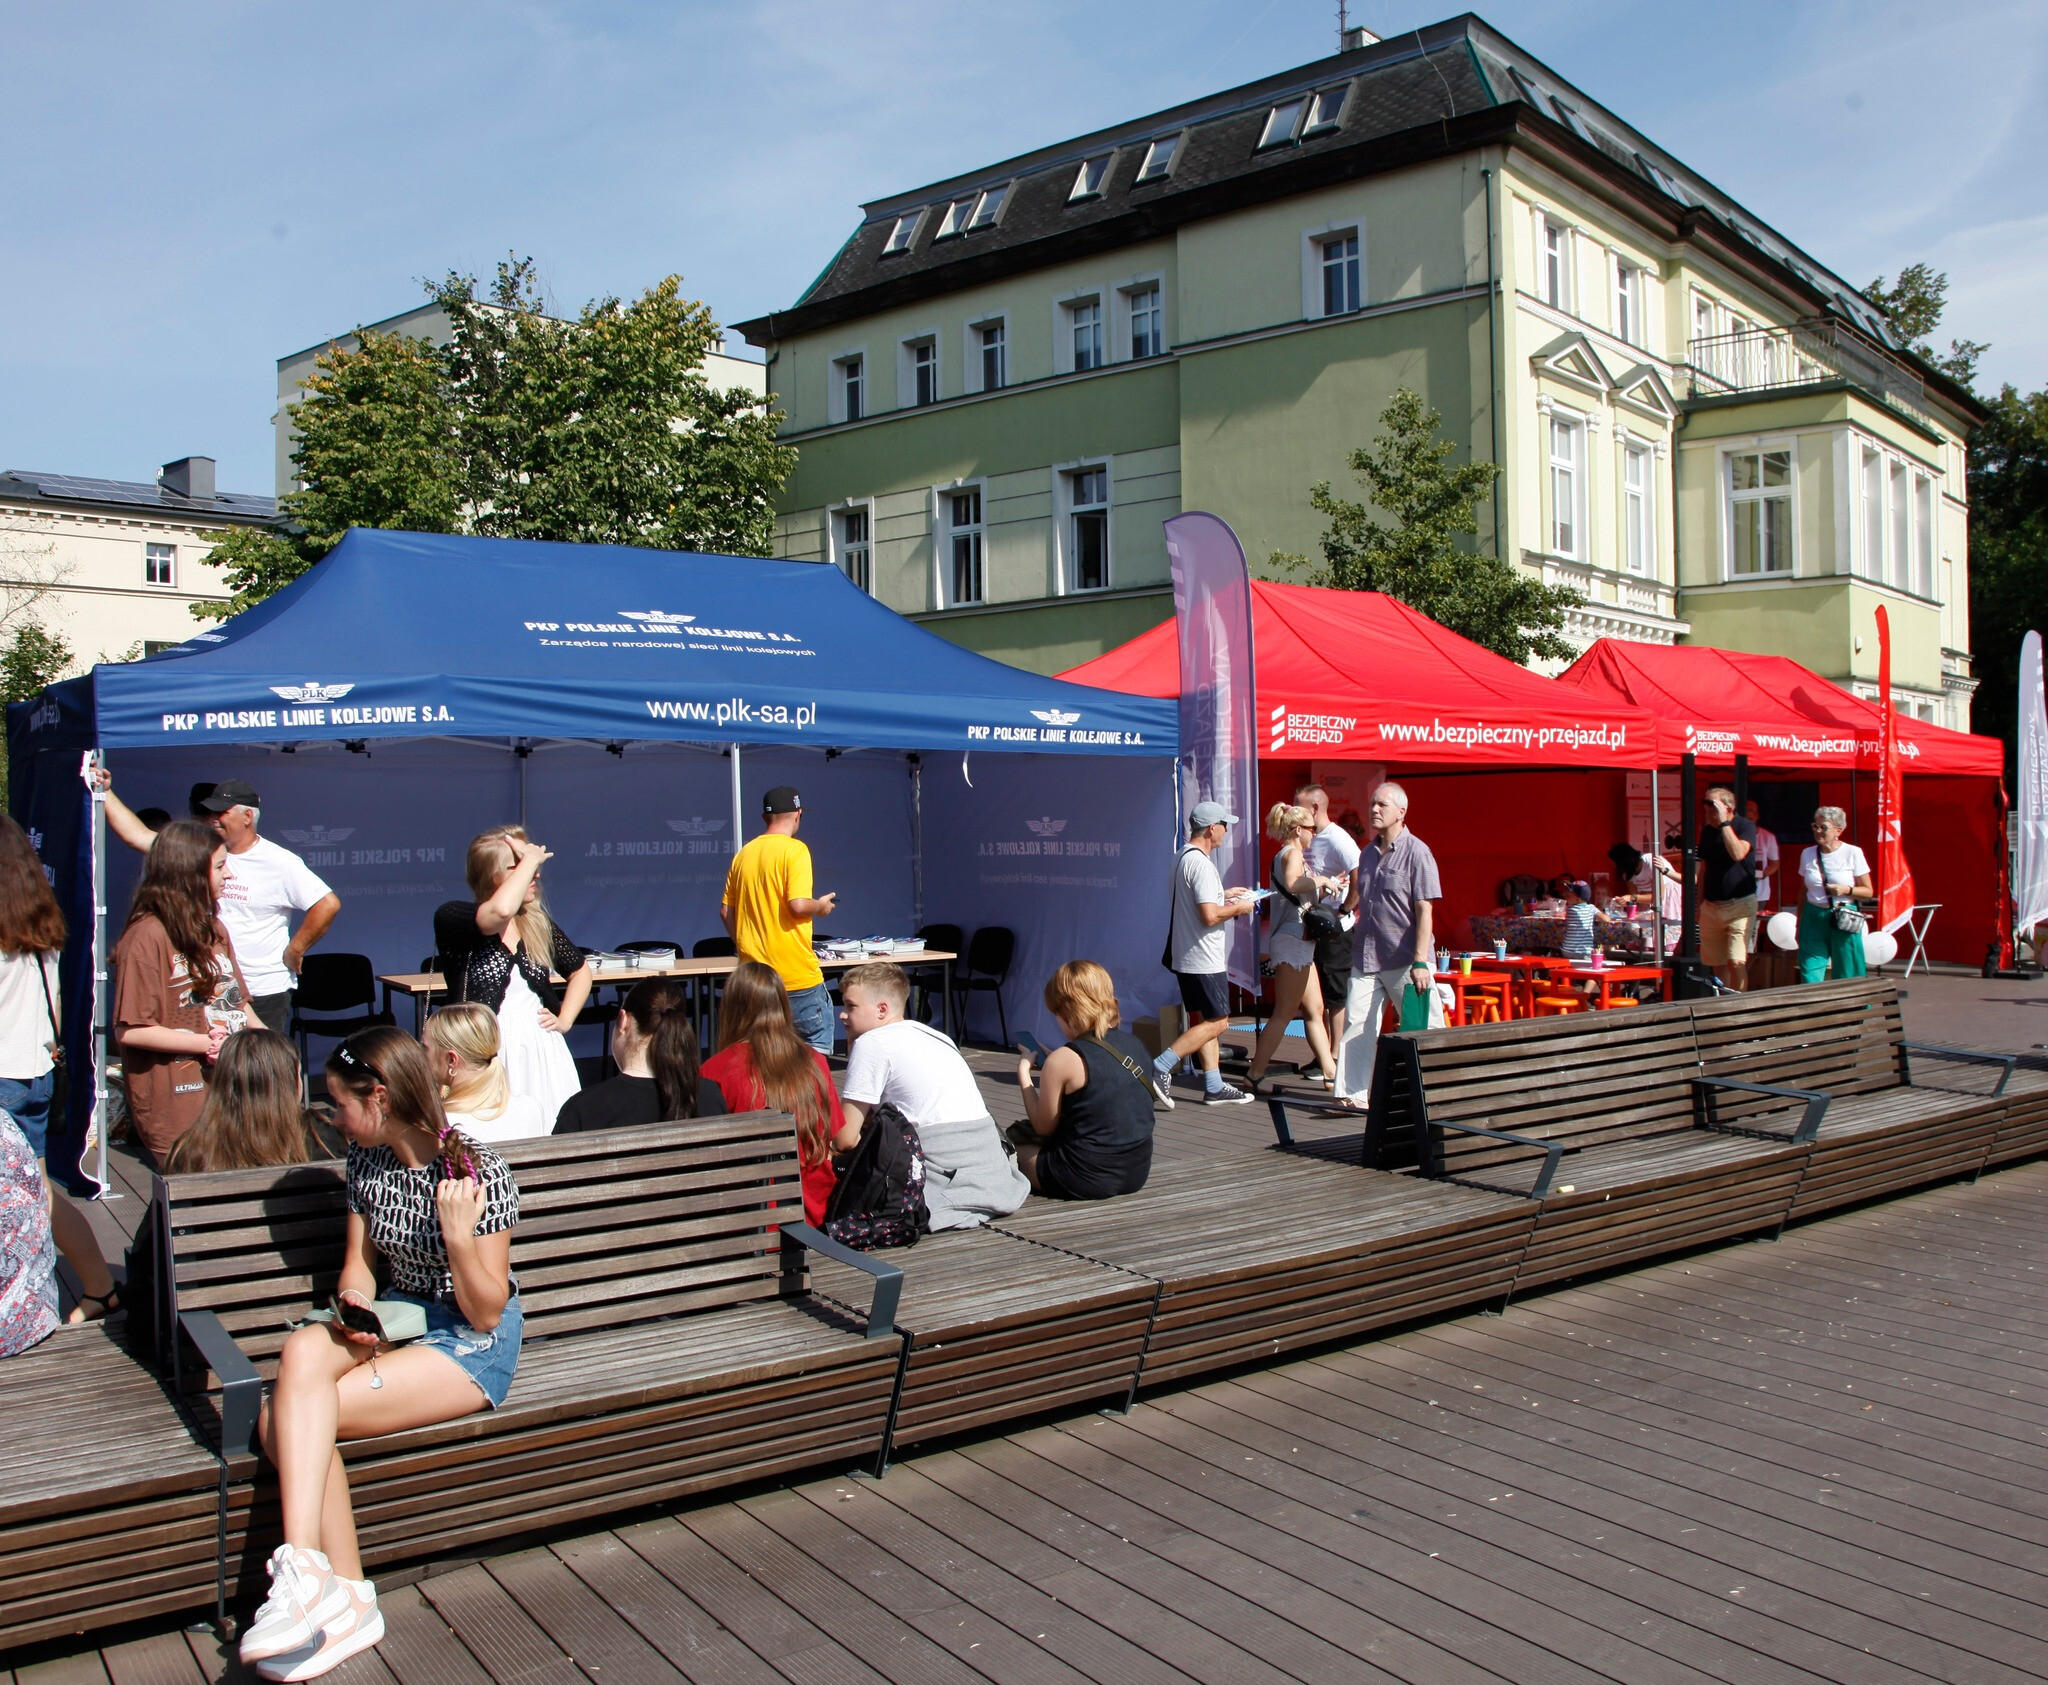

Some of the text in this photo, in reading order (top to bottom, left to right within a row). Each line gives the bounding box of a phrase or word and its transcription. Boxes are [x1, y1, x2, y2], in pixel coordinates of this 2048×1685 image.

[524, 622, 802, 642] PKP POLSKIE LINIE KOLEJOWE S.A.
[539, 638, 816, 657] Zarządca narodowej sieci linii kolejowych
[301, 688, 326, 699] PLK
[163, 705, 455, 731] PKP POLSKIE LINIE KOLEJOWE S.A.
[646, 697, 816, 730] www.plk-sa.pl
[1288, 714, 1357, 731] BEZPIECZNY
[968, 725, 1145, 746] PKP POLSKIE LINIE KOLEJOWE S.A.
[1288, 728, 1343, 744] PRZEJAZD
[1379, 718, 1626, 750] www.bezpieczny-przejazd.pl
[1698, 741, 1734, 754] PRZEJAZD
[340, 1049, 355, 1064] Los
